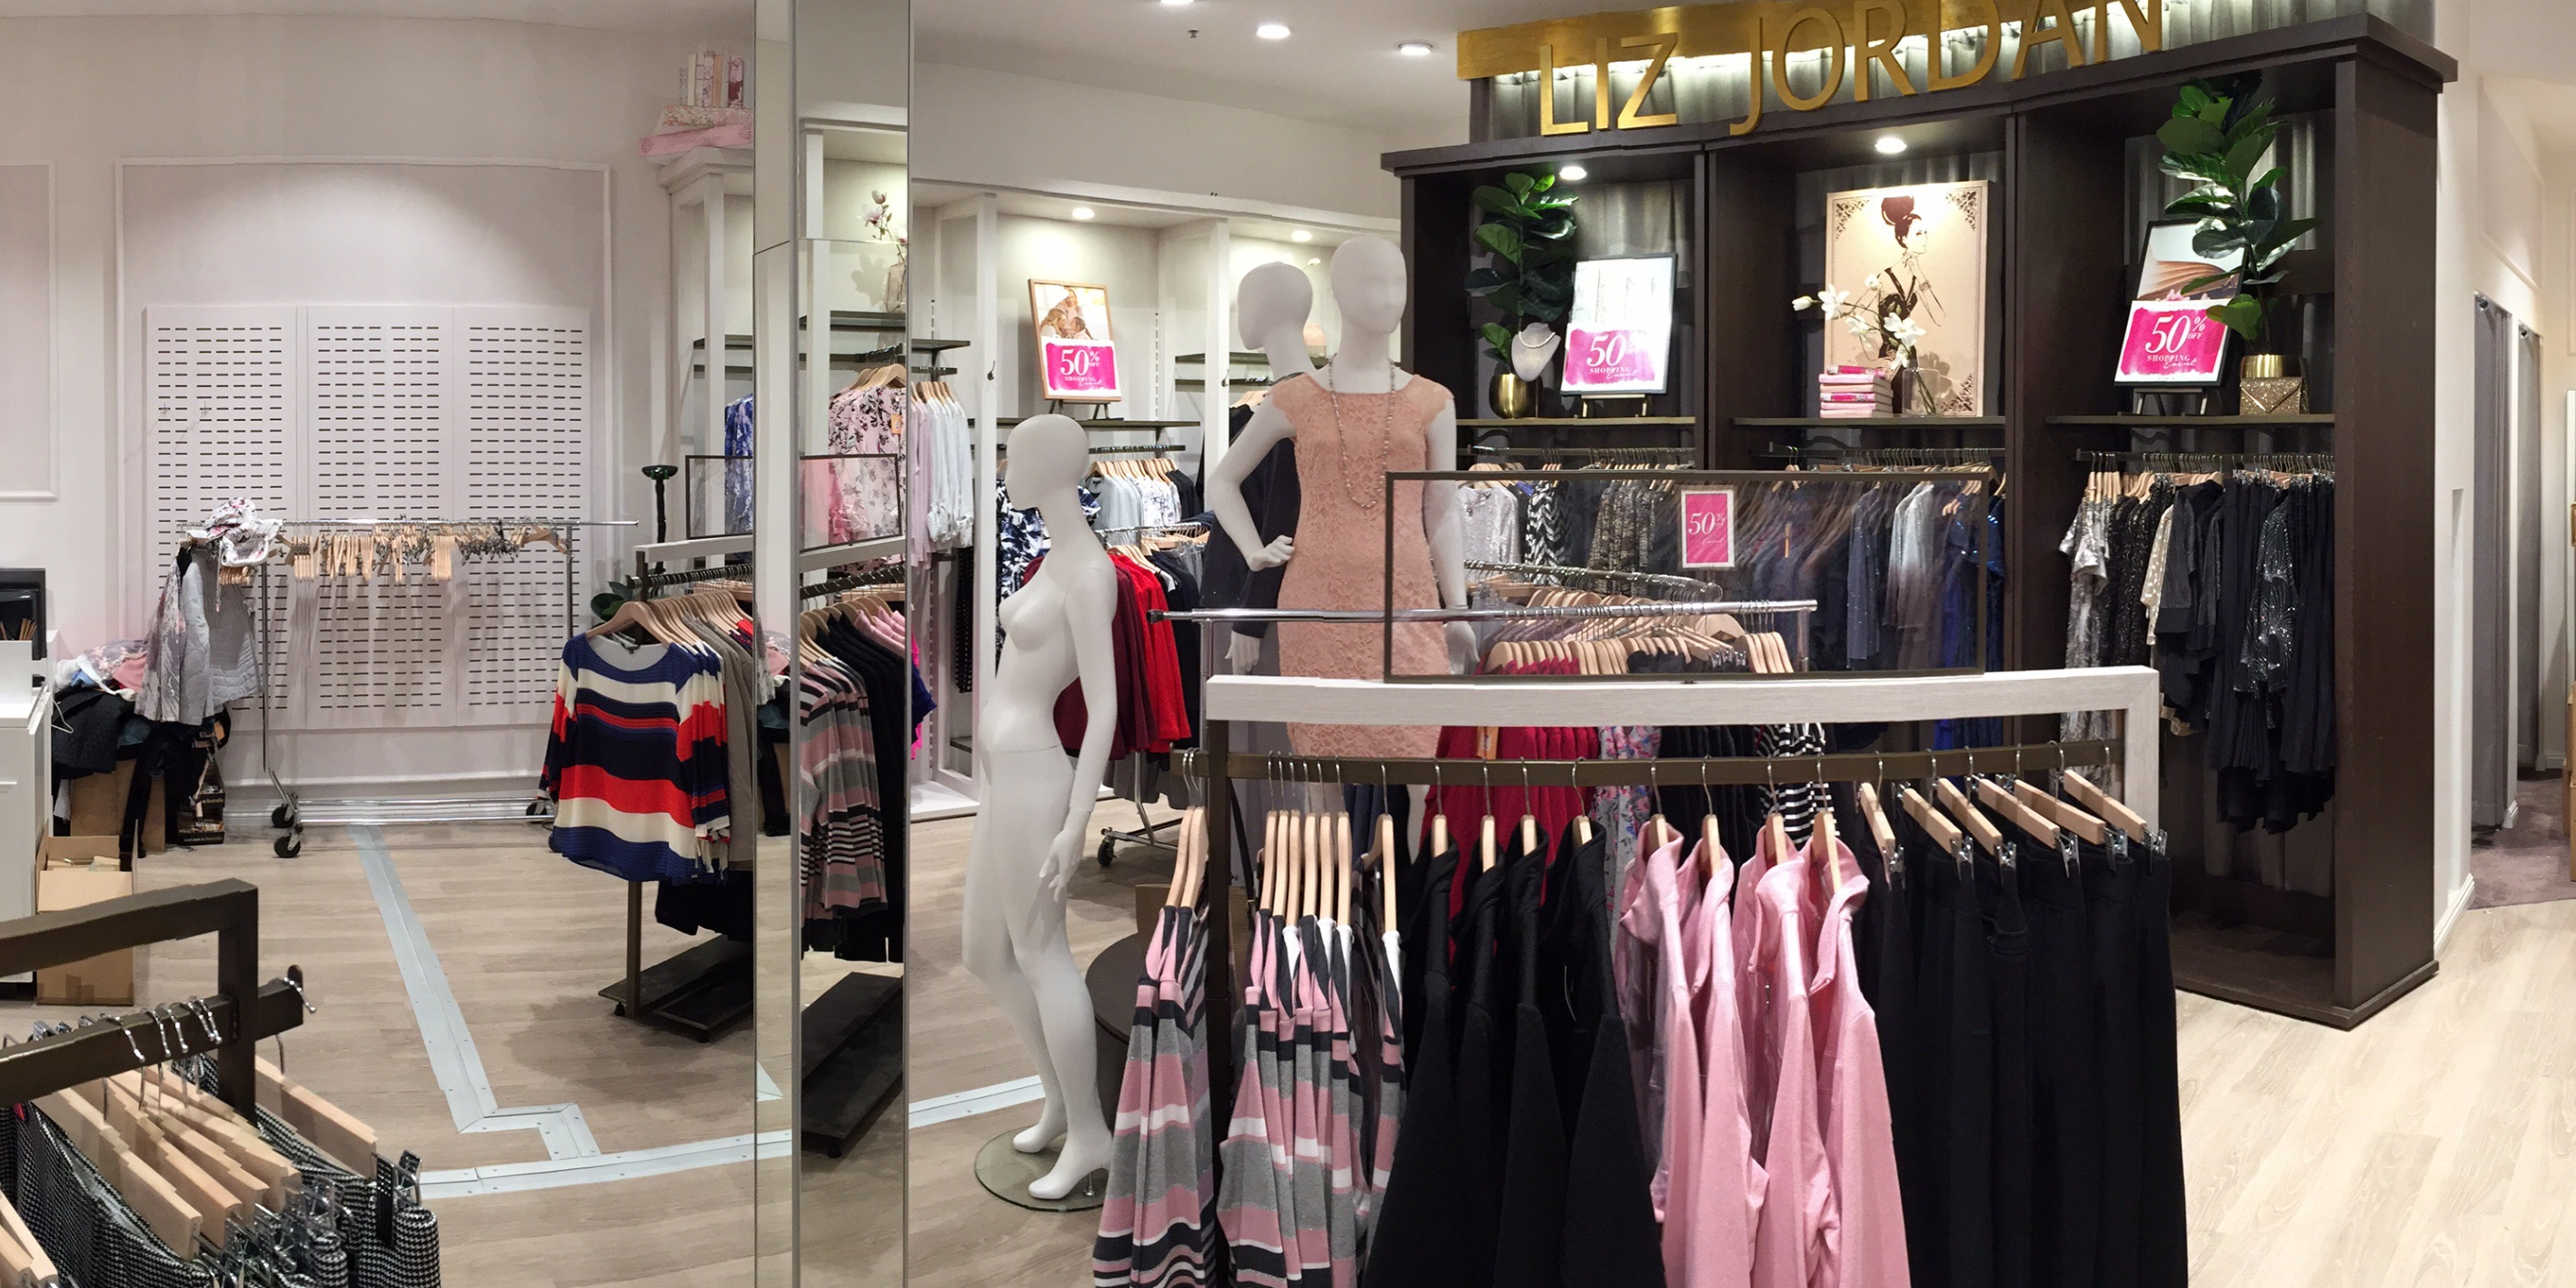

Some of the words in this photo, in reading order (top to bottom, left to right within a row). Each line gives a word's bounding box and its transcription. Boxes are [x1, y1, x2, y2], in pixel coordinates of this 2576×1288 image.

[1539, 32, 1678, 136] LIZ
[1729, 0, 2163, 136] JORDAN
[2187, 332, 2203, 340] OFF
